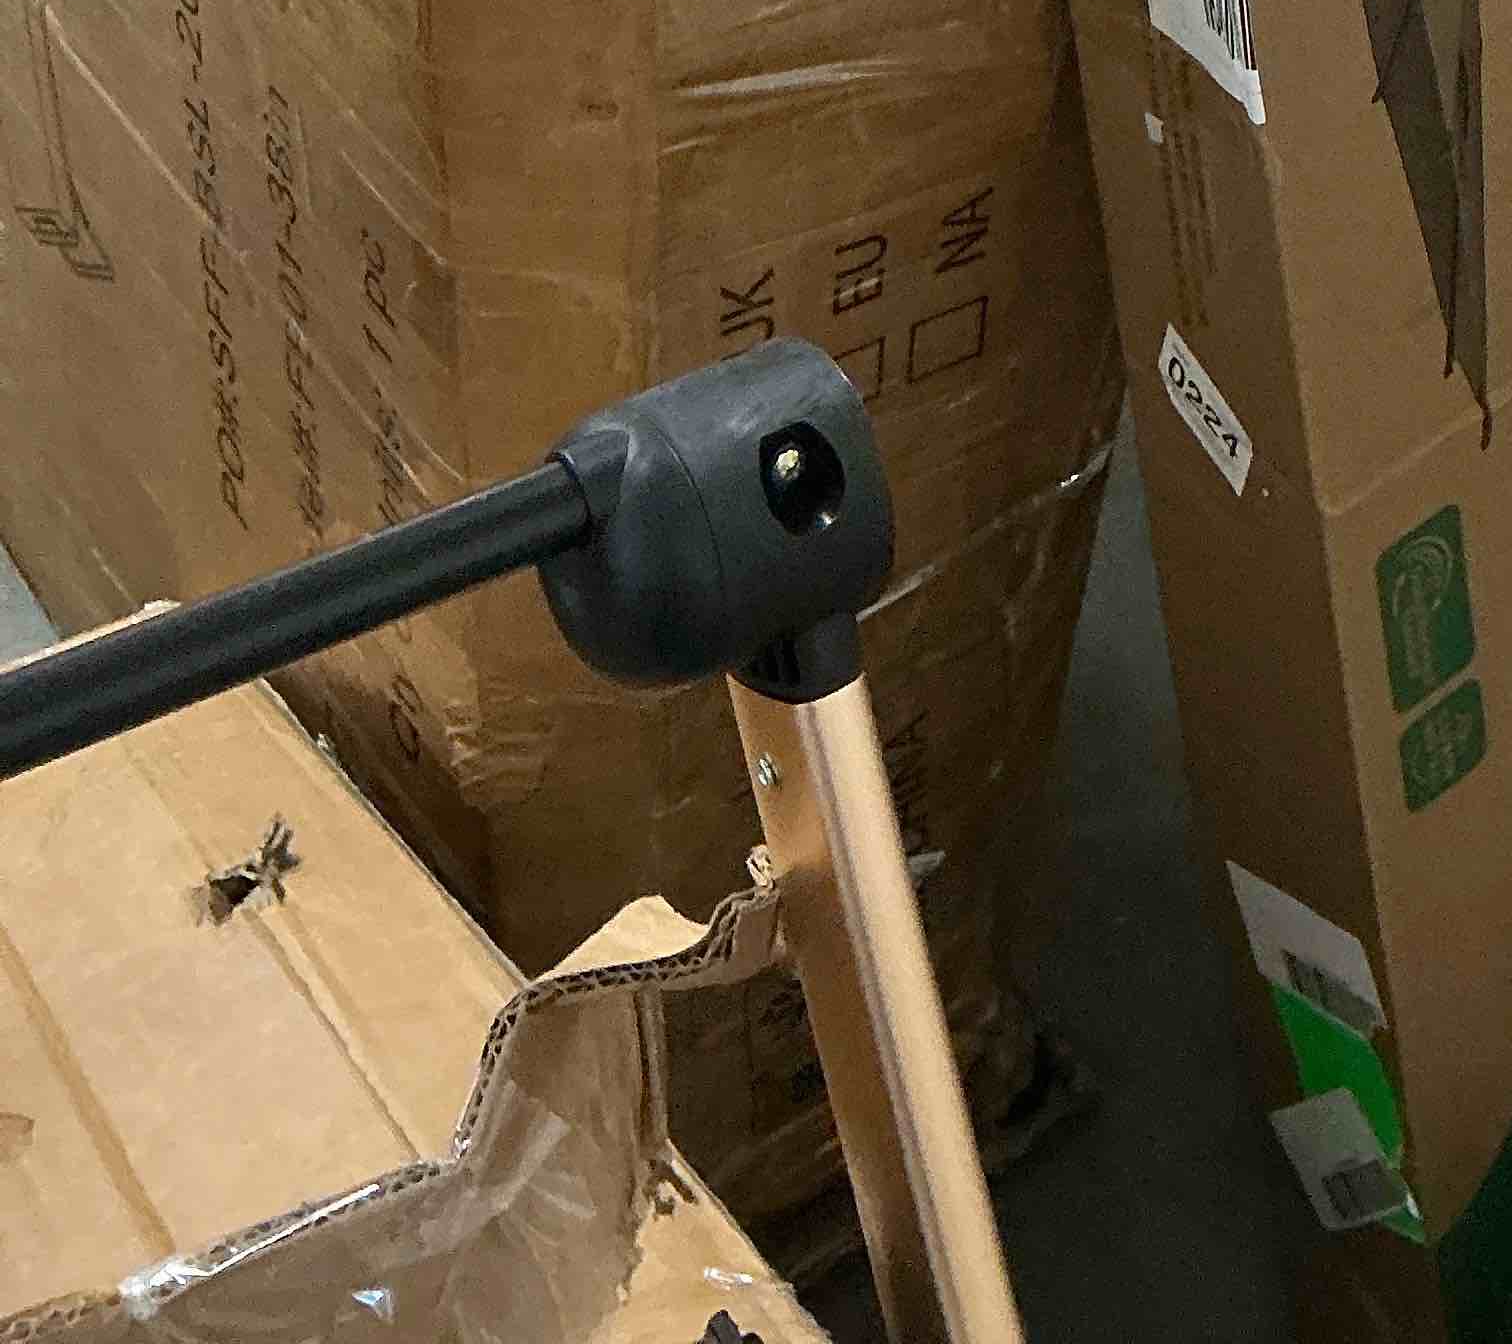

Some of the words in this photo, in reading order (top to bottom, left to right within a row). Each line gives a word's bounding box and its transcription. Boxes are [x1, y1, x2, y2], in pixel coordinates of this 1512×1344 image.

[934, 187, 993, 274] NA
[832, 235, 888, 315] EU
[1168, 357, 1240, 460] 0224
